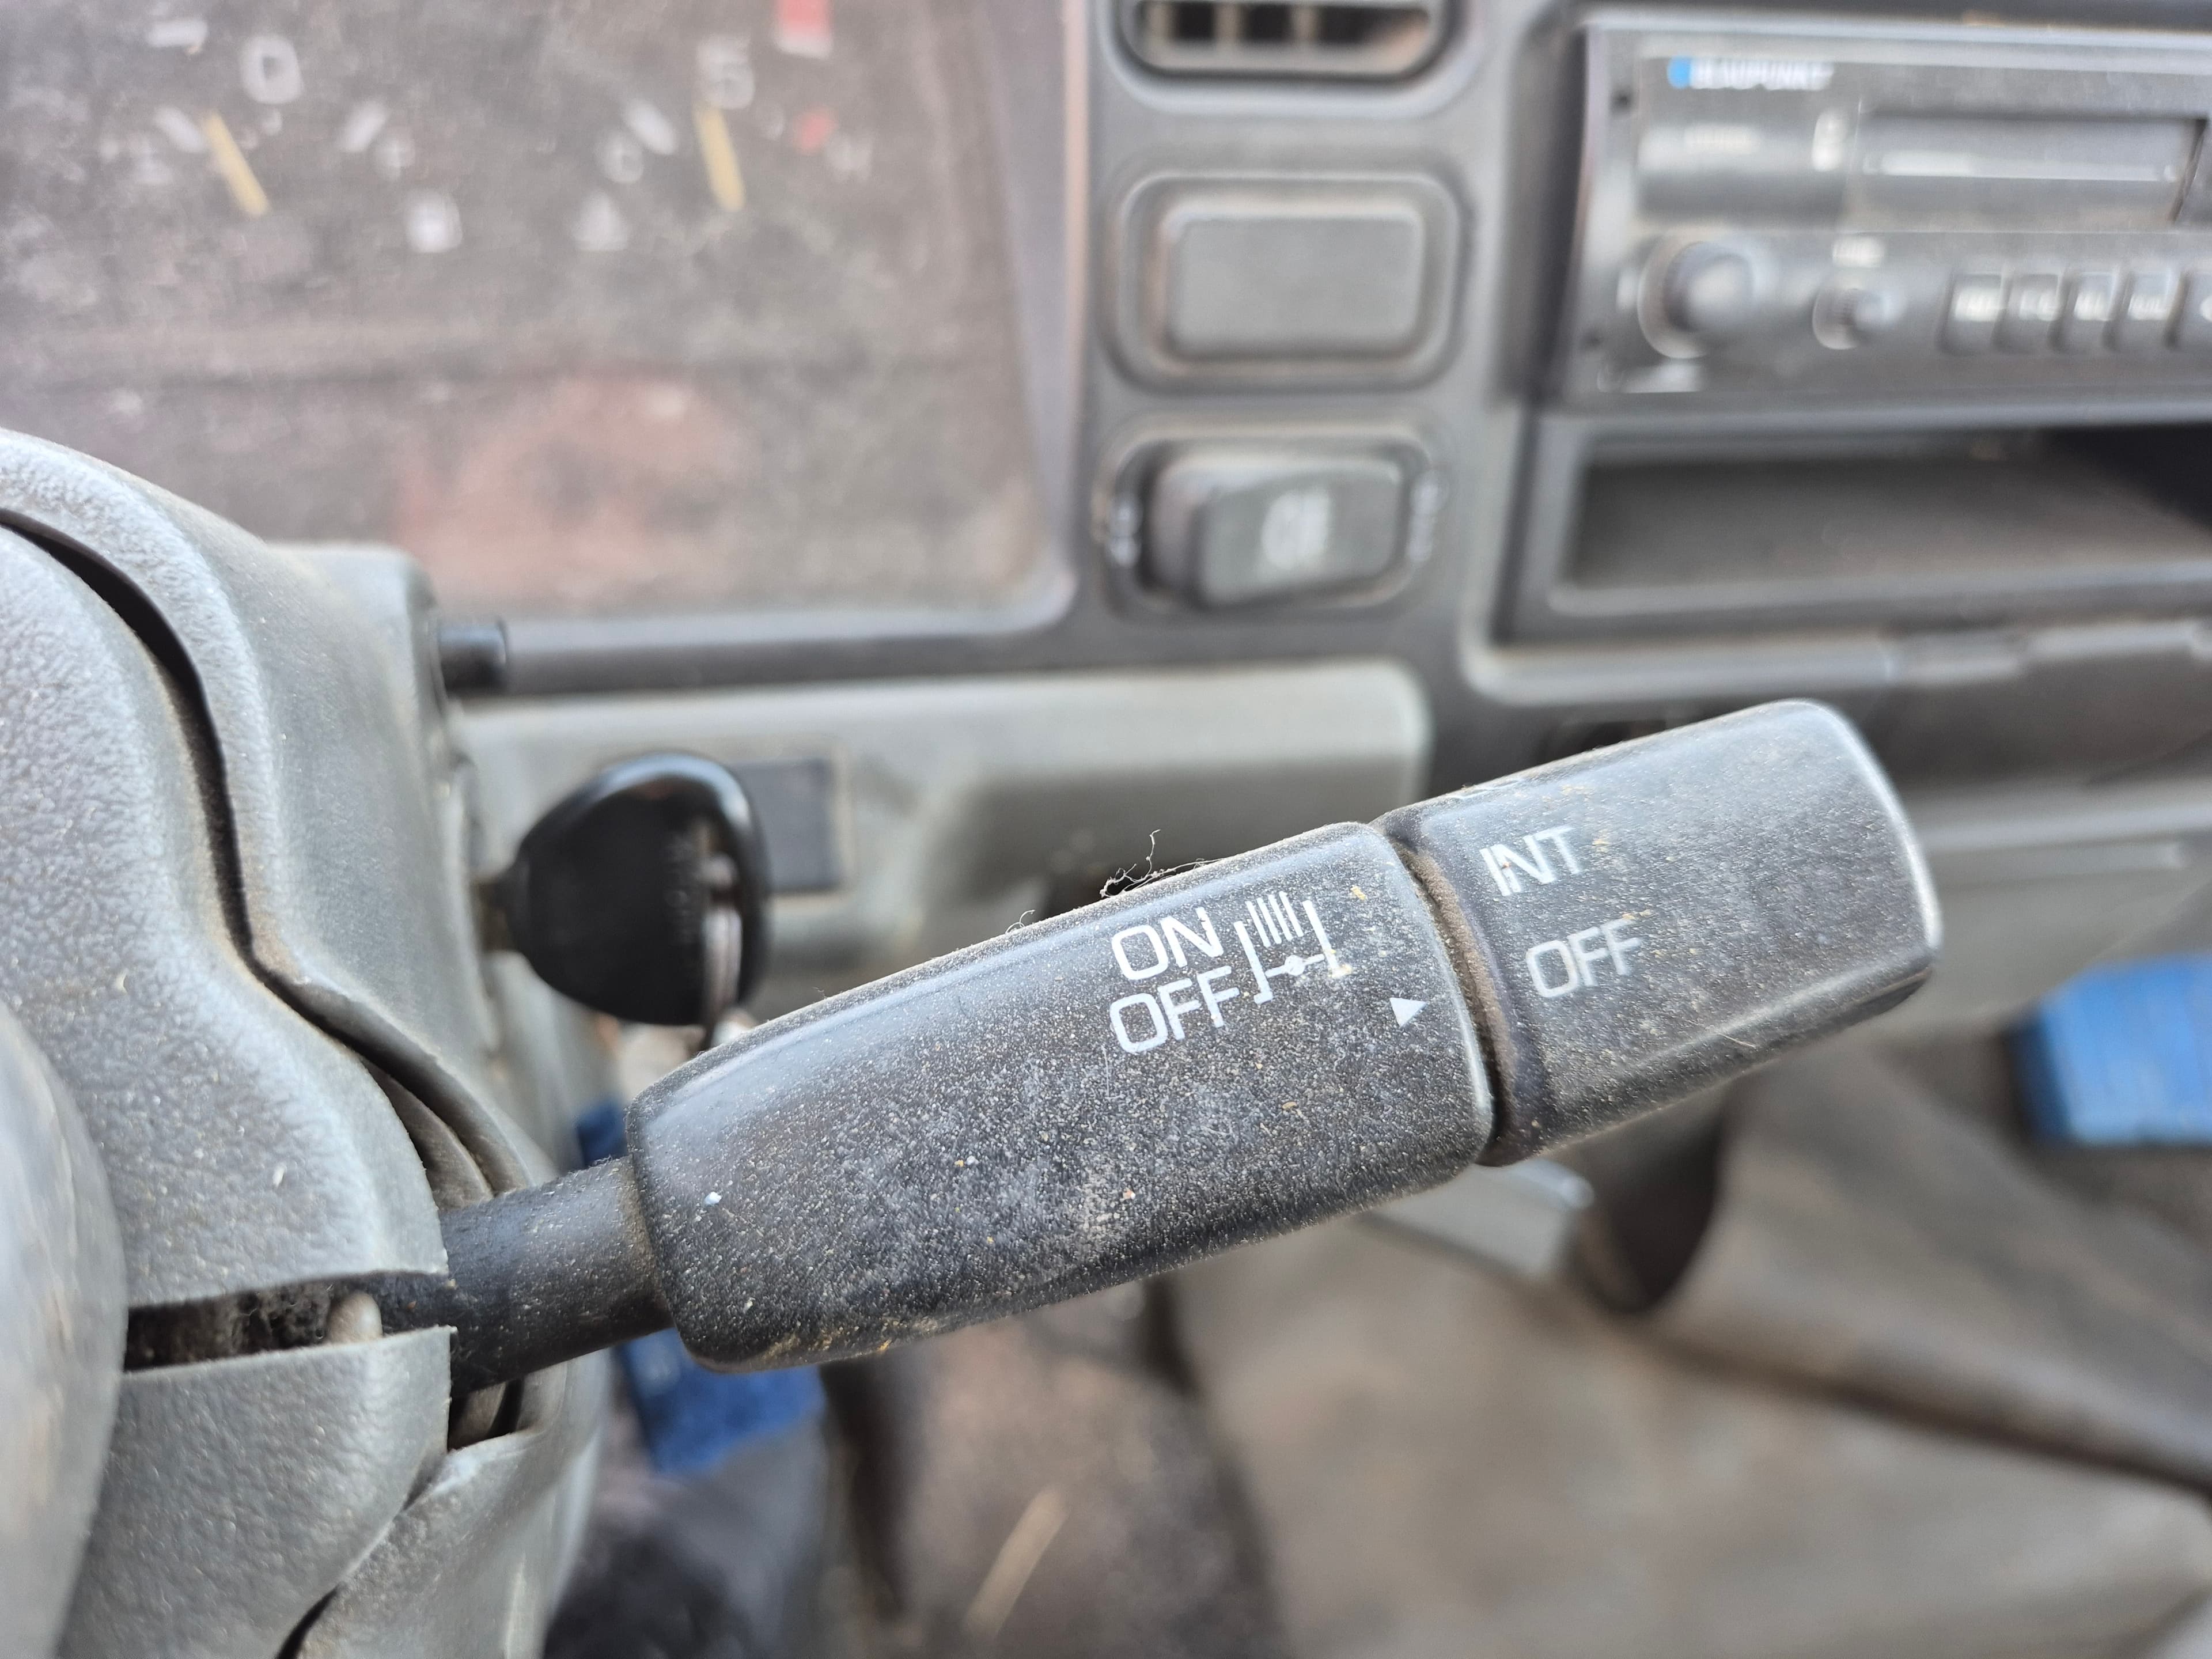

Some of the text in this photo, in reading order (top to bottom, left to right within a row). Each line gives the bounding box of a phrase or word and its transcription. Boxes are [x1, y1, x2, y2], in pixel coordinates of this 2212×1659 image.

[1479, 825, 1575, 896] INT
[1111, 907, 1224, 980] ON
[1525, 918, 1642, 998] OFF
[1109, 965, 1240, 1053] OFF
